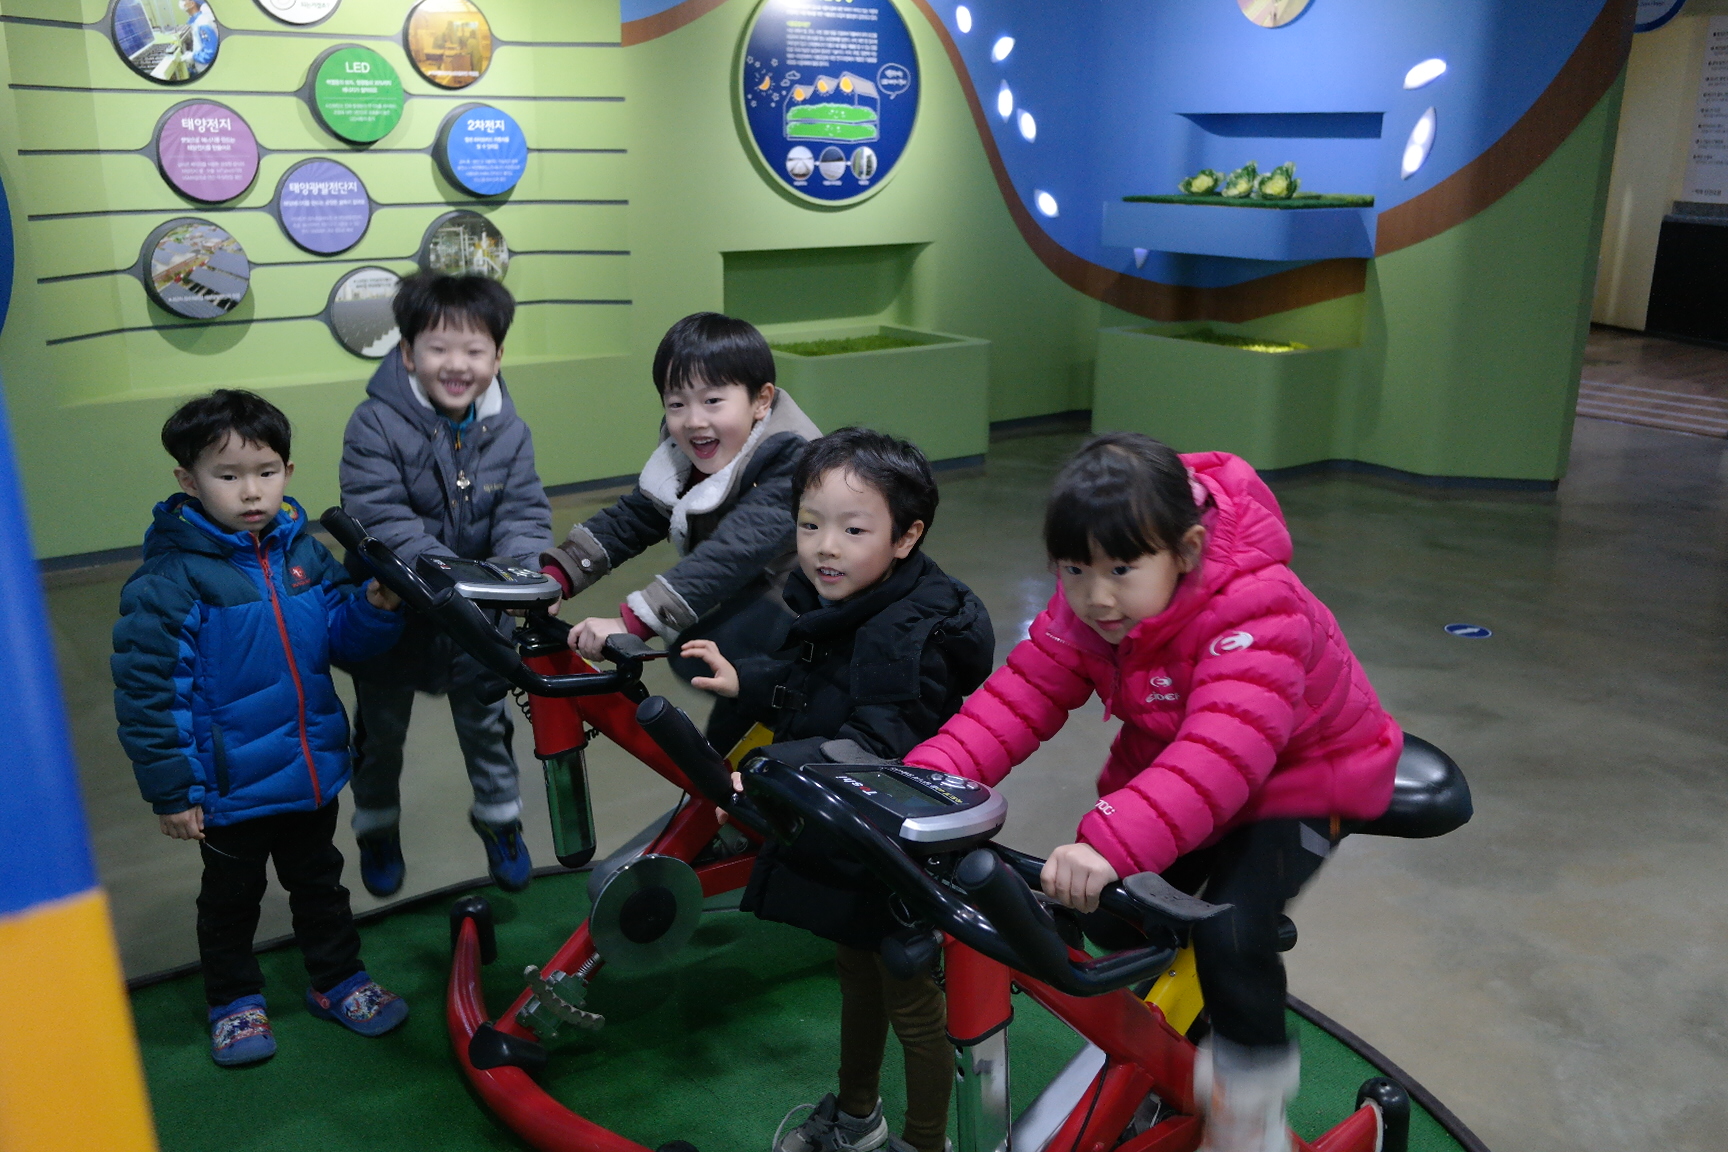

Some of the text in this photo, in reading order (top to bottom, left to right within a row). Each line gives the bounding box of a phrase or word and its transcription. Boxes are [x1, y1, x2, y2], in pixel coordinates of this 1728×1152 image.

[345, 61, 371, 73] LED
[181, 117, 232, 133] 태양전지
[467, 119, 505, 133] 2차전지
[289, 181, 358, 195] 태양광발전단지
